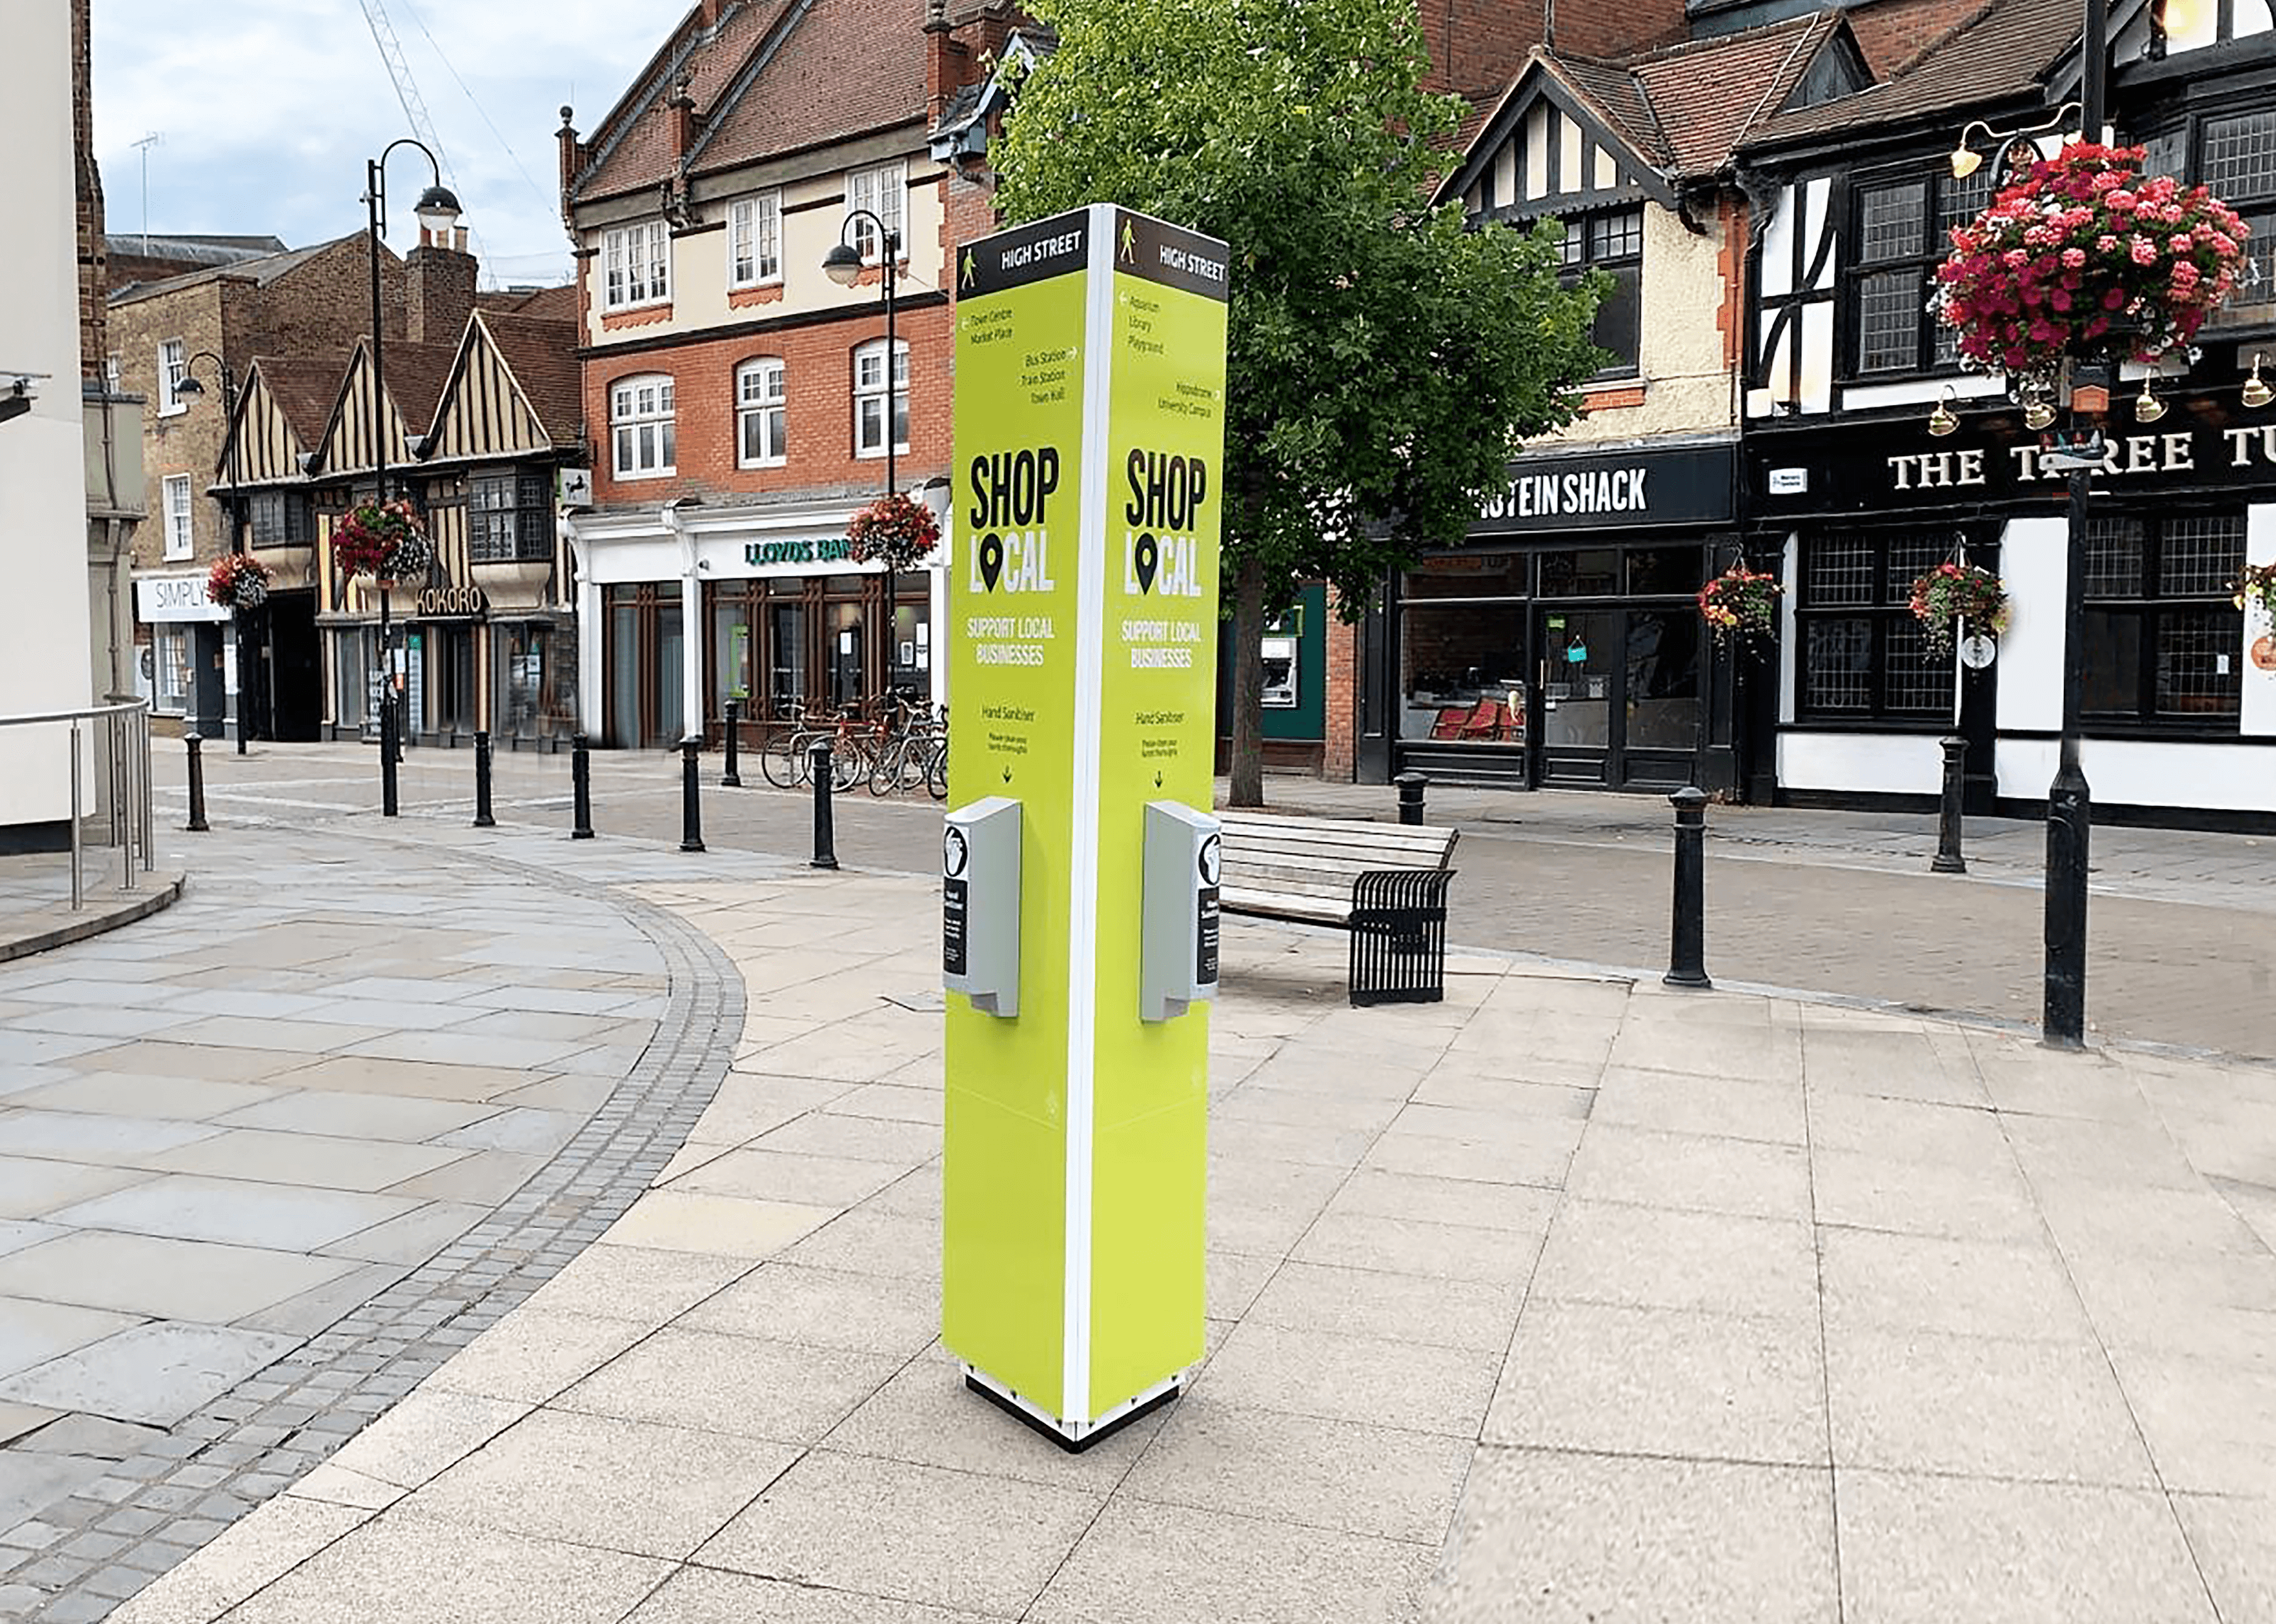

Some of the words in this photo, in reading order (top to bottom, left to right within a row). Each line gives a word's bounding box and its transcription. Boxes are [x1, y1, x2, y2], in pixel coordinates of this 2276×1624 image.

[1001, 244, 1032, 270] HIGH
[1034, 230, 1082, 261] STREET
[1160, 244, 1186, 270] HIGH
[1187, 254, 1225, 281] STREET
[1129, 315, 1152, 334] Library
[1025, 354, 1039, 367] Bus
[1039, 351, 1066, 365] Station
[1020, 375, 1039, 386] Train
[1039, 370, 1066, 385] Station
[1888, 449, 1986, 489] THE
[2010, 431, 2194, 481] TREE
[971, 447, 1059, 529] SHOP
[1126, 448, 1206, 531] SHOP
[1478, 475, 1559, 520] OTEIN
[1562, 468, 1647, 514] SHACK
[745, 540, 814, 567] LLOYDS
[816, 539, 850, 563] BAN
[155, 581, 205, 608] SIMPLY
[415, 587, 481, 614] KOKORO
[966, 616, 1015, 639] SUPPORT
[1017, 616, 1055, 639] LOCAL
[1122, 619, 1167, 642] SUPPORT
[1170, 621, 1201, 642] LOCAL
[975, 643, 1045, 666] BUSINESSES
[1130, 648, 1192, 668] BUSINESSES
[981, 704, 1002, 719] Hand
[1135, 711, 1154, 725] Hand
